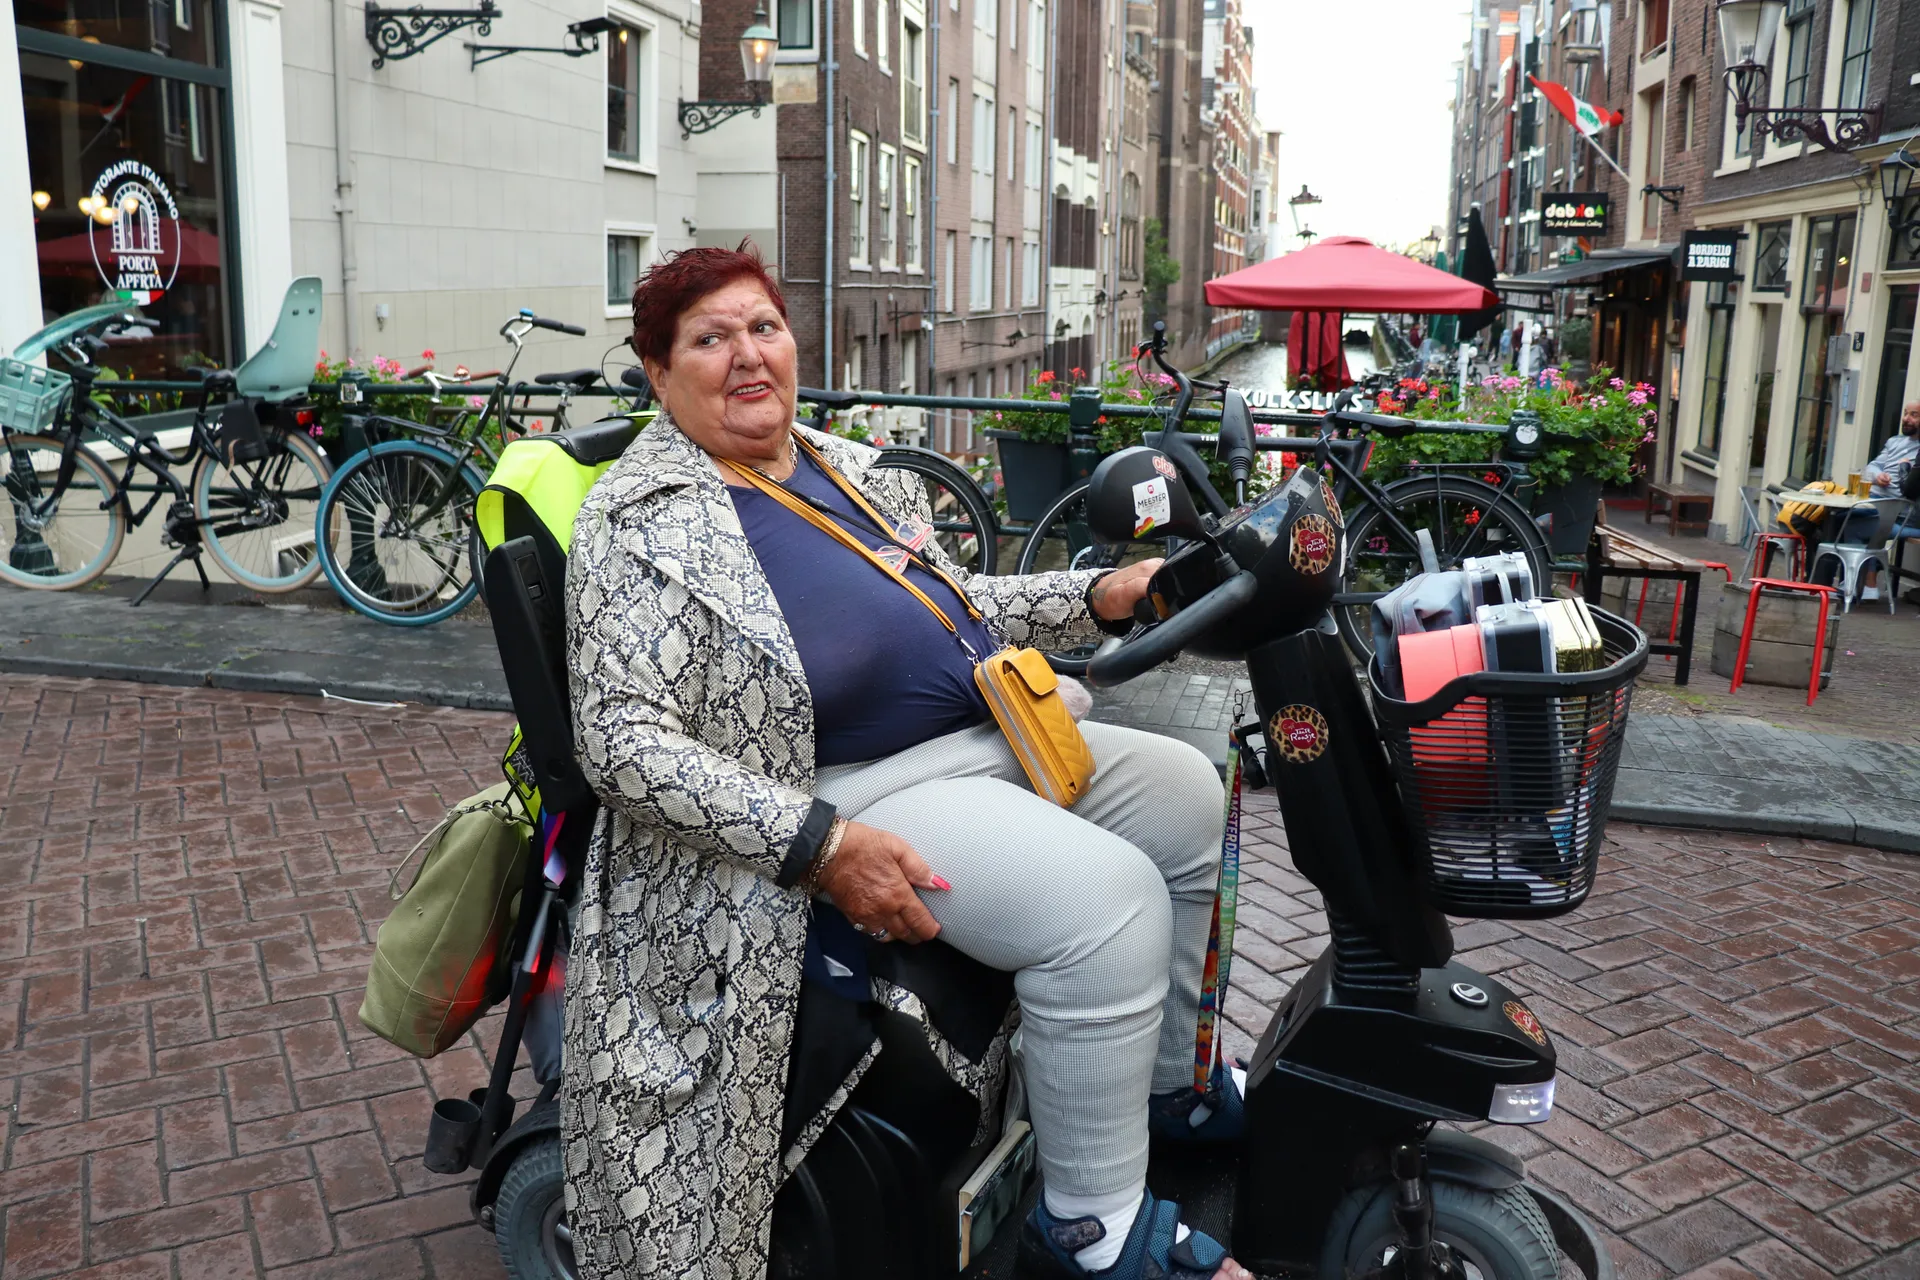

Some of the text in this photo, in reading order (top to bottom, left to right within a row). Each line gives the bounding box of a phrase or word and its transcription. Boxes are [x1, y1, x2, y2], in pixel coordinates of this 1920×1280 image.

[90, 160, 179, 220] STORANTE ITALIANO
[1688, 243, 1732, 256] BORDELLO
[119, 255, 158, 273] PORTA
[1239, 388, 1364, 413] KOLKSLUS
[1137, 493, 1167, 509] MEESTER
[1221, 885, 1235, 909] 750
